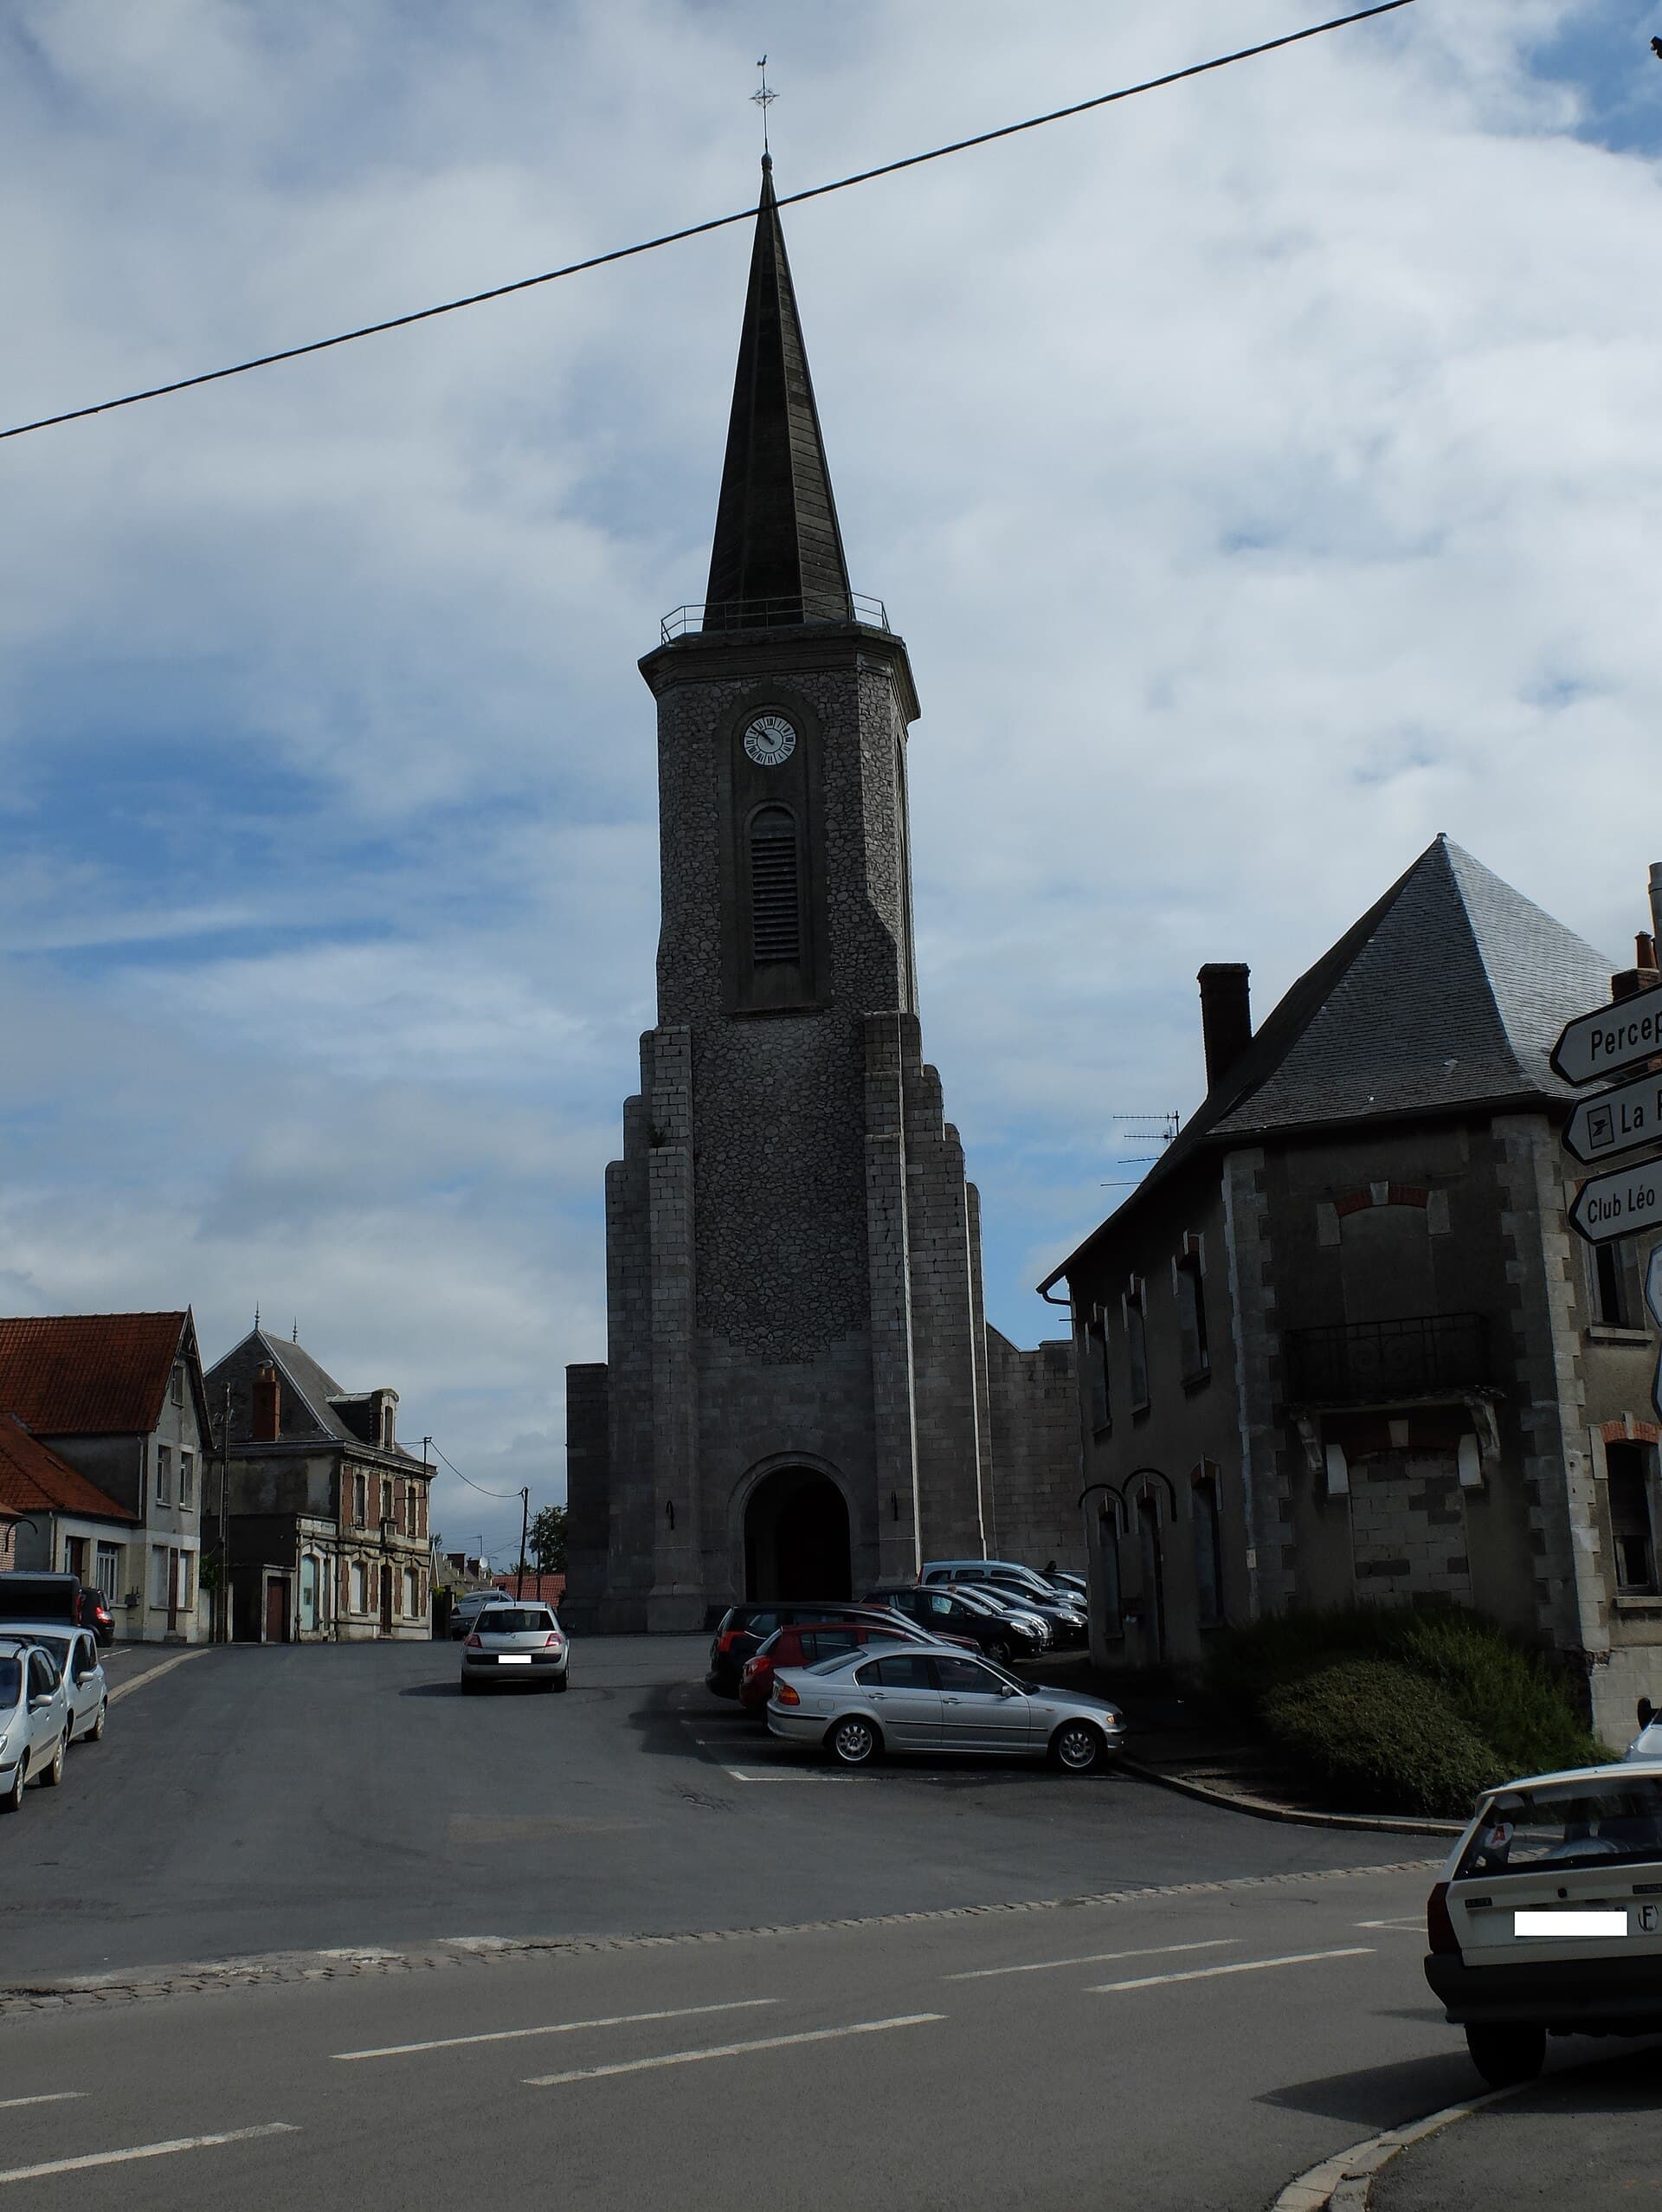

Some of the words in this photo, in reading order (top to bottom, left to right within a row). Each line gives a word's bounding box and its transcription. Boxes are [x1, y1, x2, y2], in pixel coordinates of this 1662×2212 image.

[1621, 1104, 1644, 1134] La
[1588, 1193, 1621, 1223] Club
[1628, 1184, 1655, 1212] Léo
